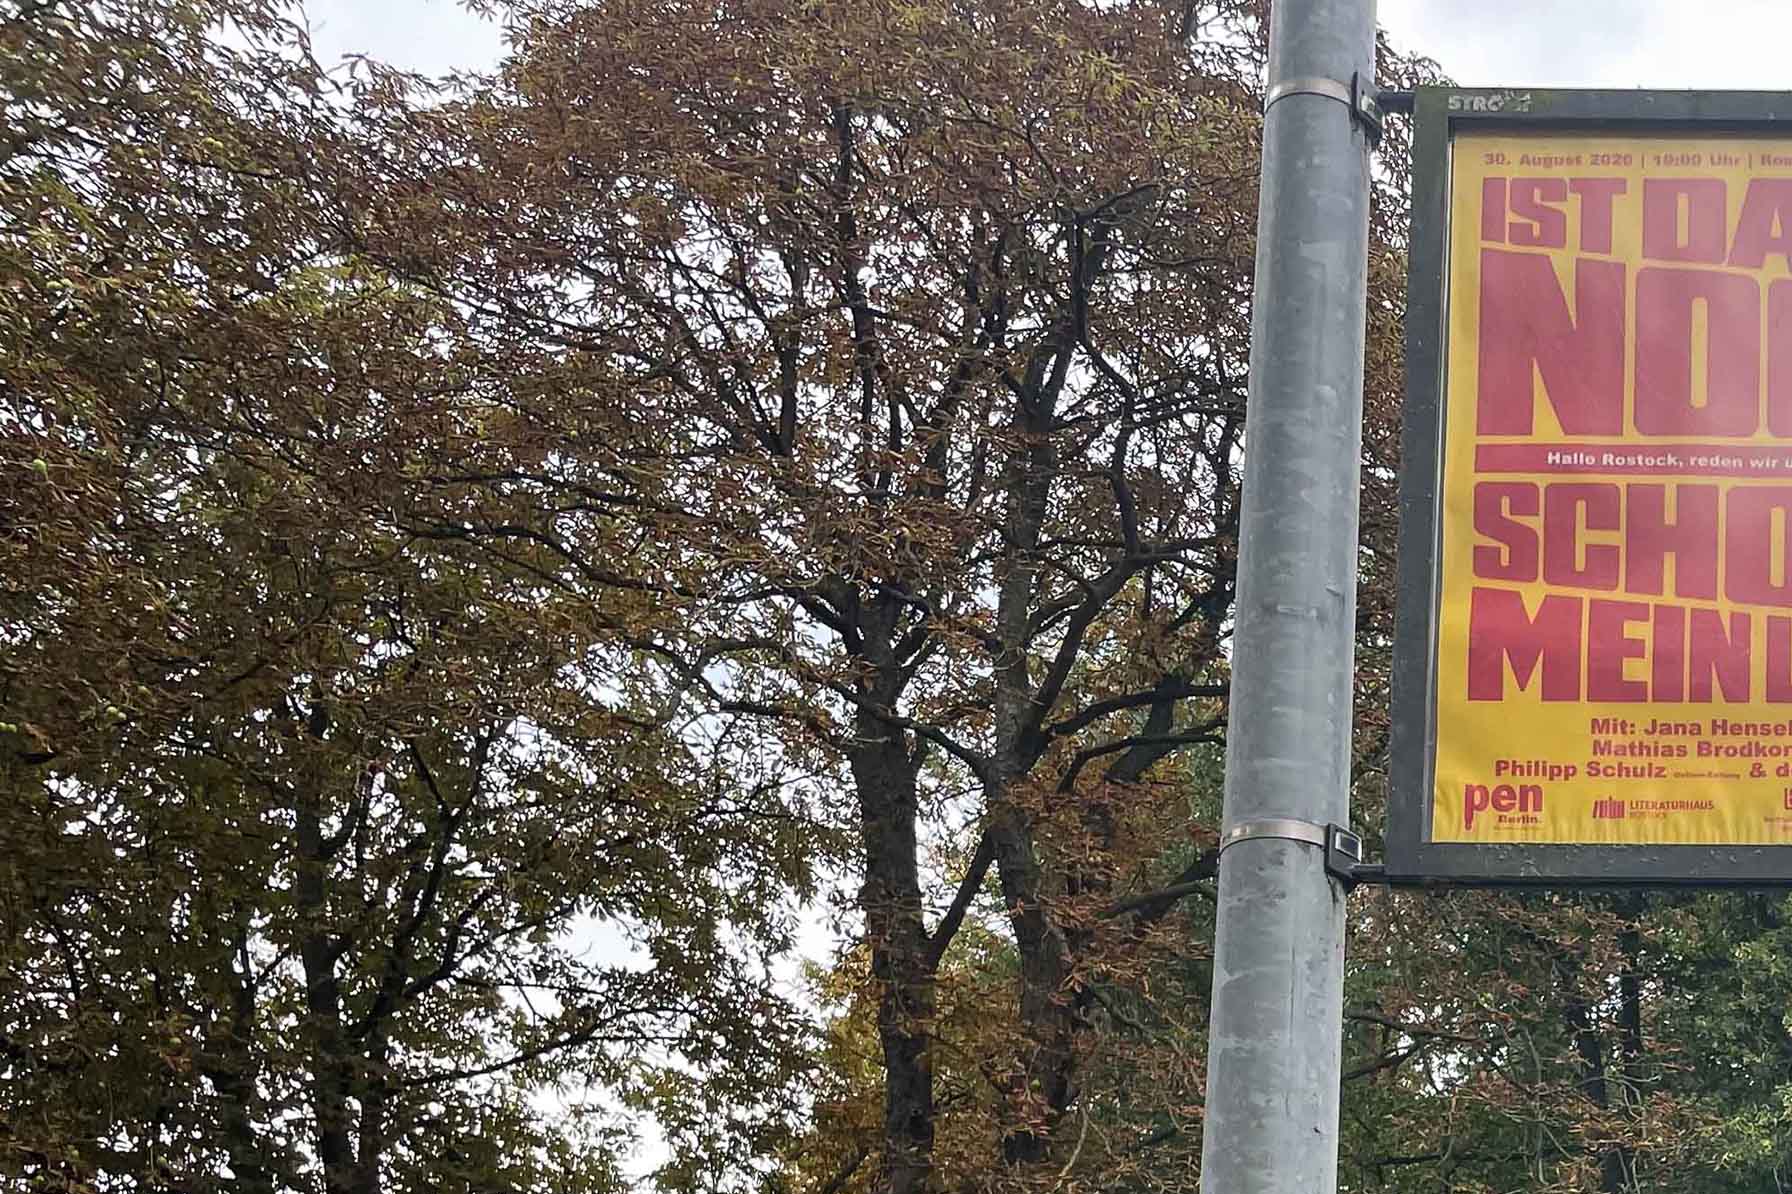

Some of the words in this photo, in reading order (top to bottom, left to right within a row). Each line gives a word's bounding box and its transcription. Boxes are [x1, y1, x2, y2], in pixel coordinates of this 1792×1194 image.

[1520, 153, 1582, 169] August
[1710, 154, 1740, 167] Uhr
[1480, 177, 1627, 254] IST
[1547, 451, 1596, 466] Hallo
[1602, 453, 1683, 469] Rostock,
[1690, 454, 1743, 468] reden
[1750, 455, 1778, 469] wir
[1468, 587, 1751, 703] MEIN
[1591, 718, 1636, 735] Mit:
[1644, 718, 1702, 736] Jana
[1593, 740, 1688, 757] Mathias
[1495, 760, 1577, 780] Philipp
[1586, 761, 1667, 779] Schulz
[1464, 783, 1543, 830] pen
[1629, 799, 1714, 812] LITERATURHAUS
